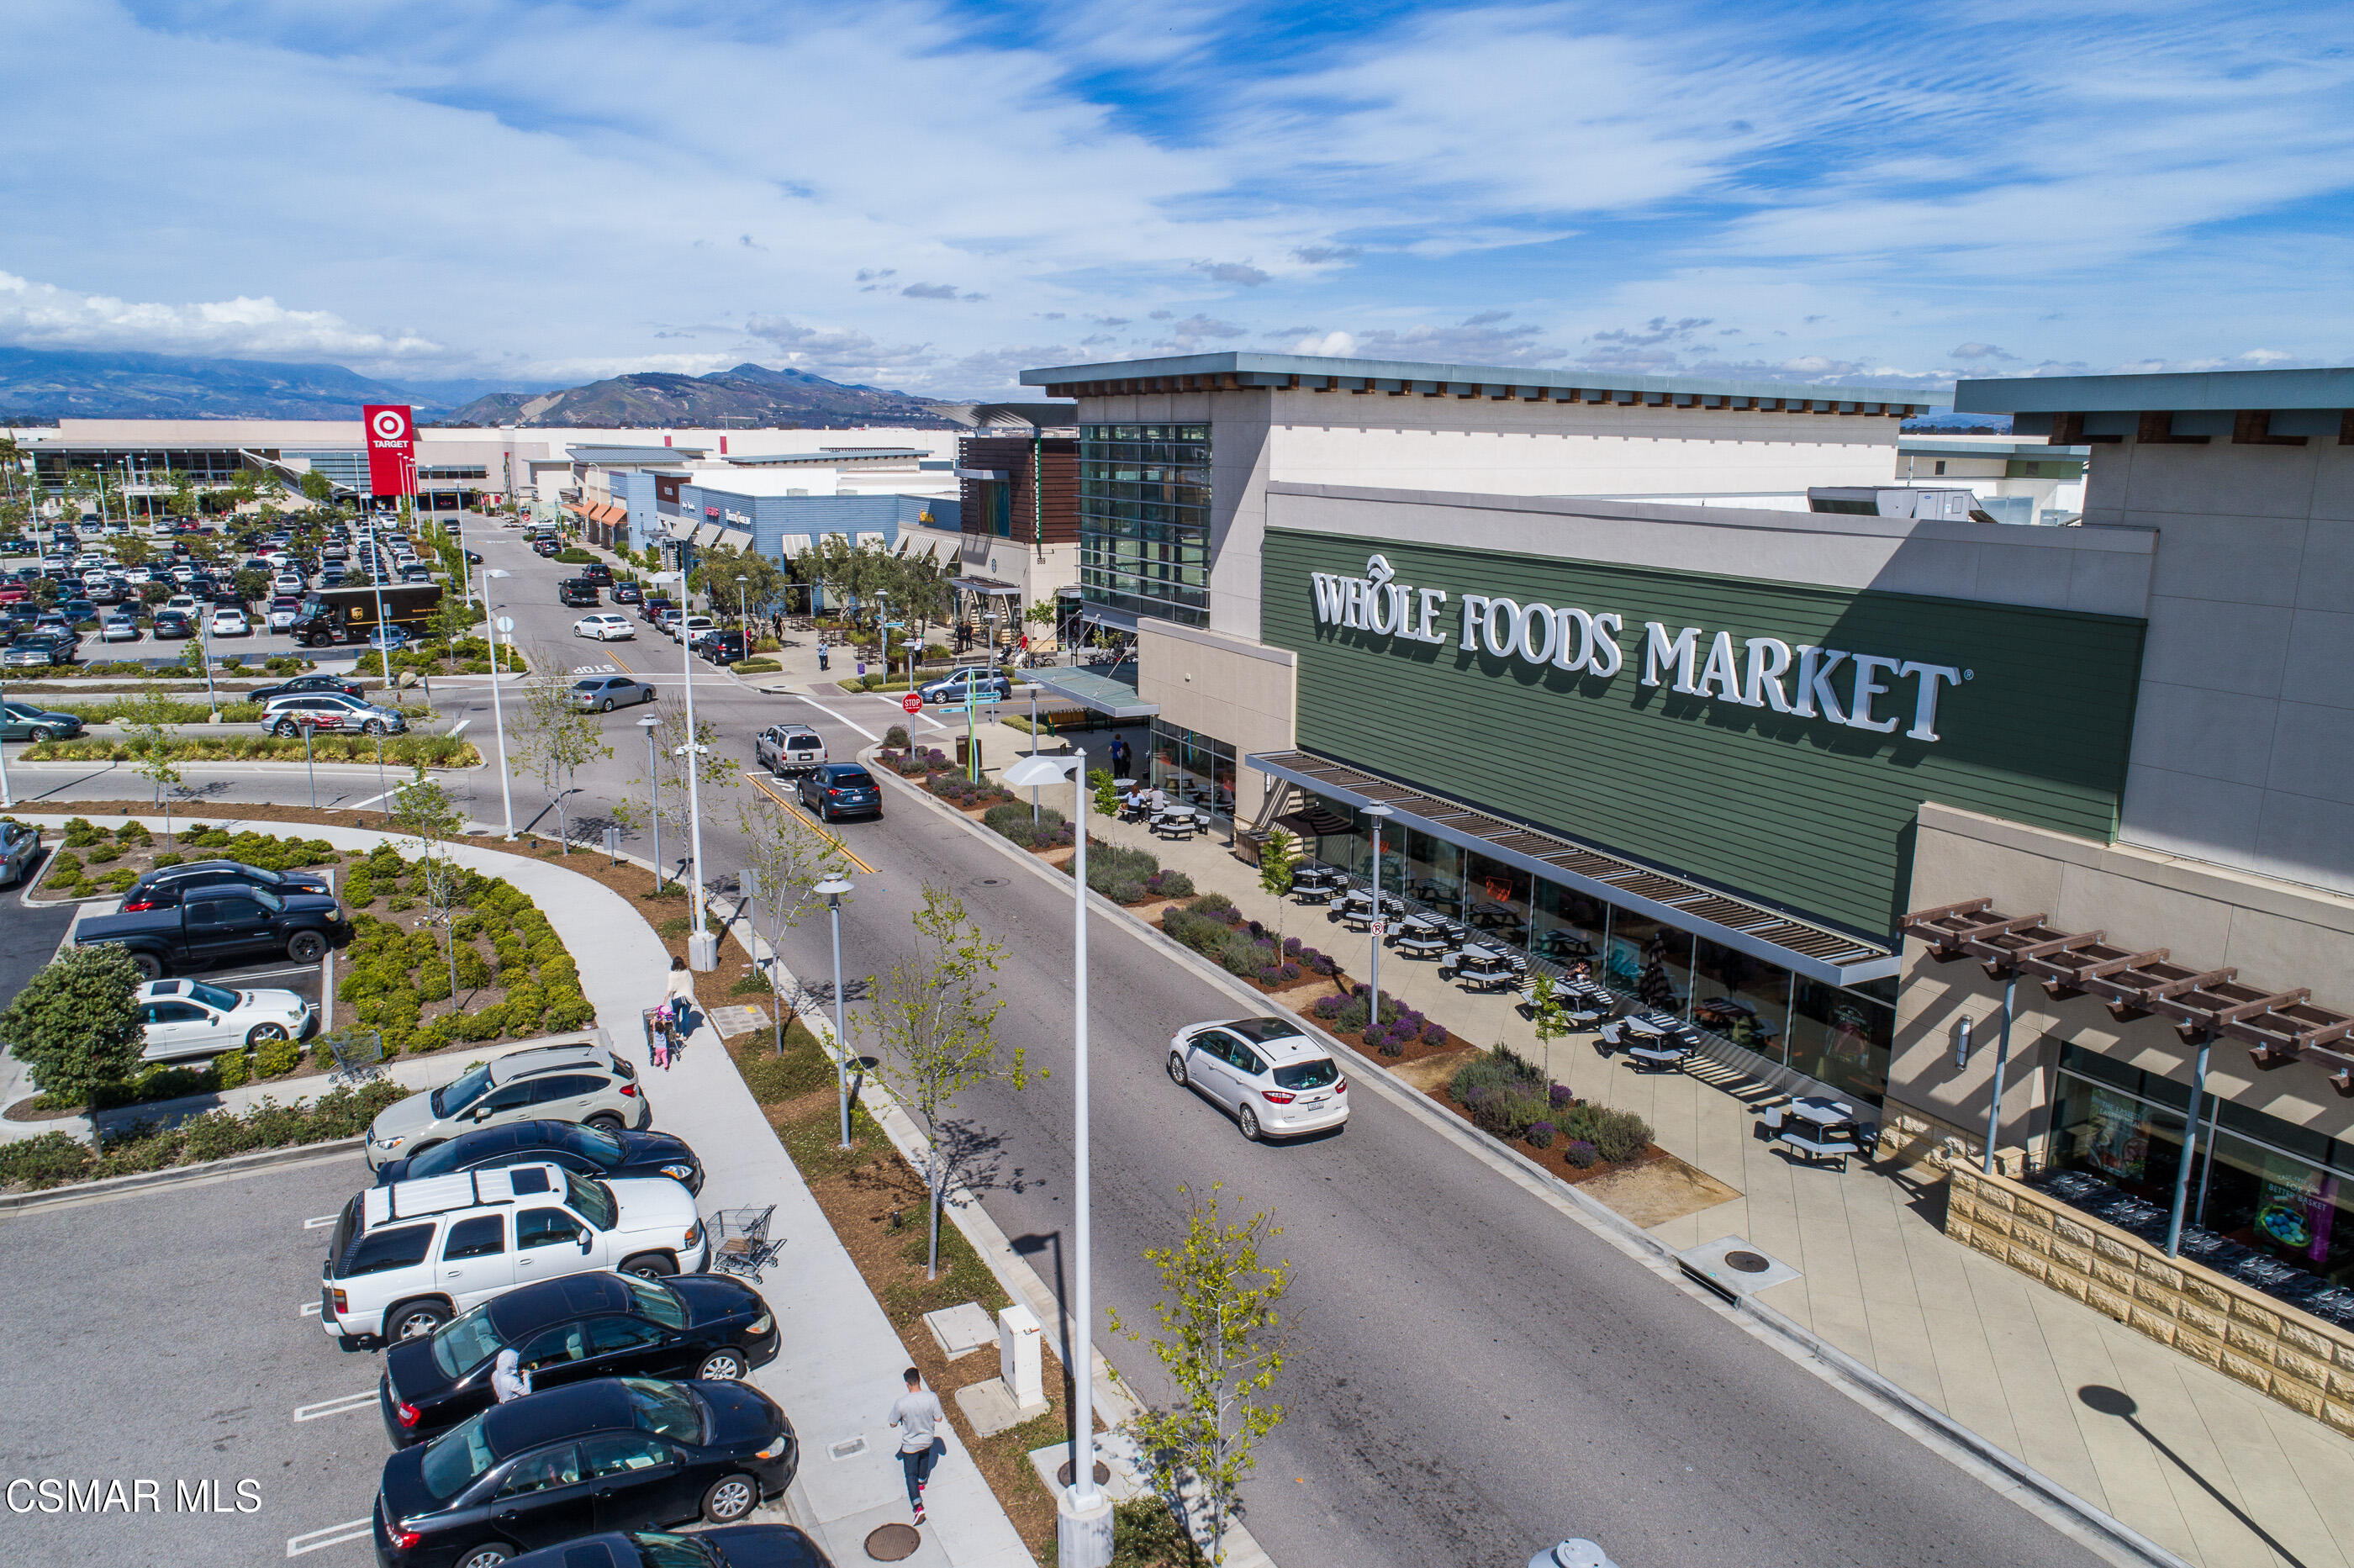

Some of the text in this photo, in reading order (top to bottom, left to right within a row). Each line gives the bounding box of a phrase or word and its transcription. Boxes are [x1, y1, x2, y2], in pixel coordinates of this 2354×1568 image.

[1311, 554, 1447, 645] WHOLE
[1460, 594, 1623, 678] FOODS
[573, 664, 616, 673] STOP
[905, 699, 921, 707] STOP
[2268, 1183, 2327, 1211] BETTER BASKET
